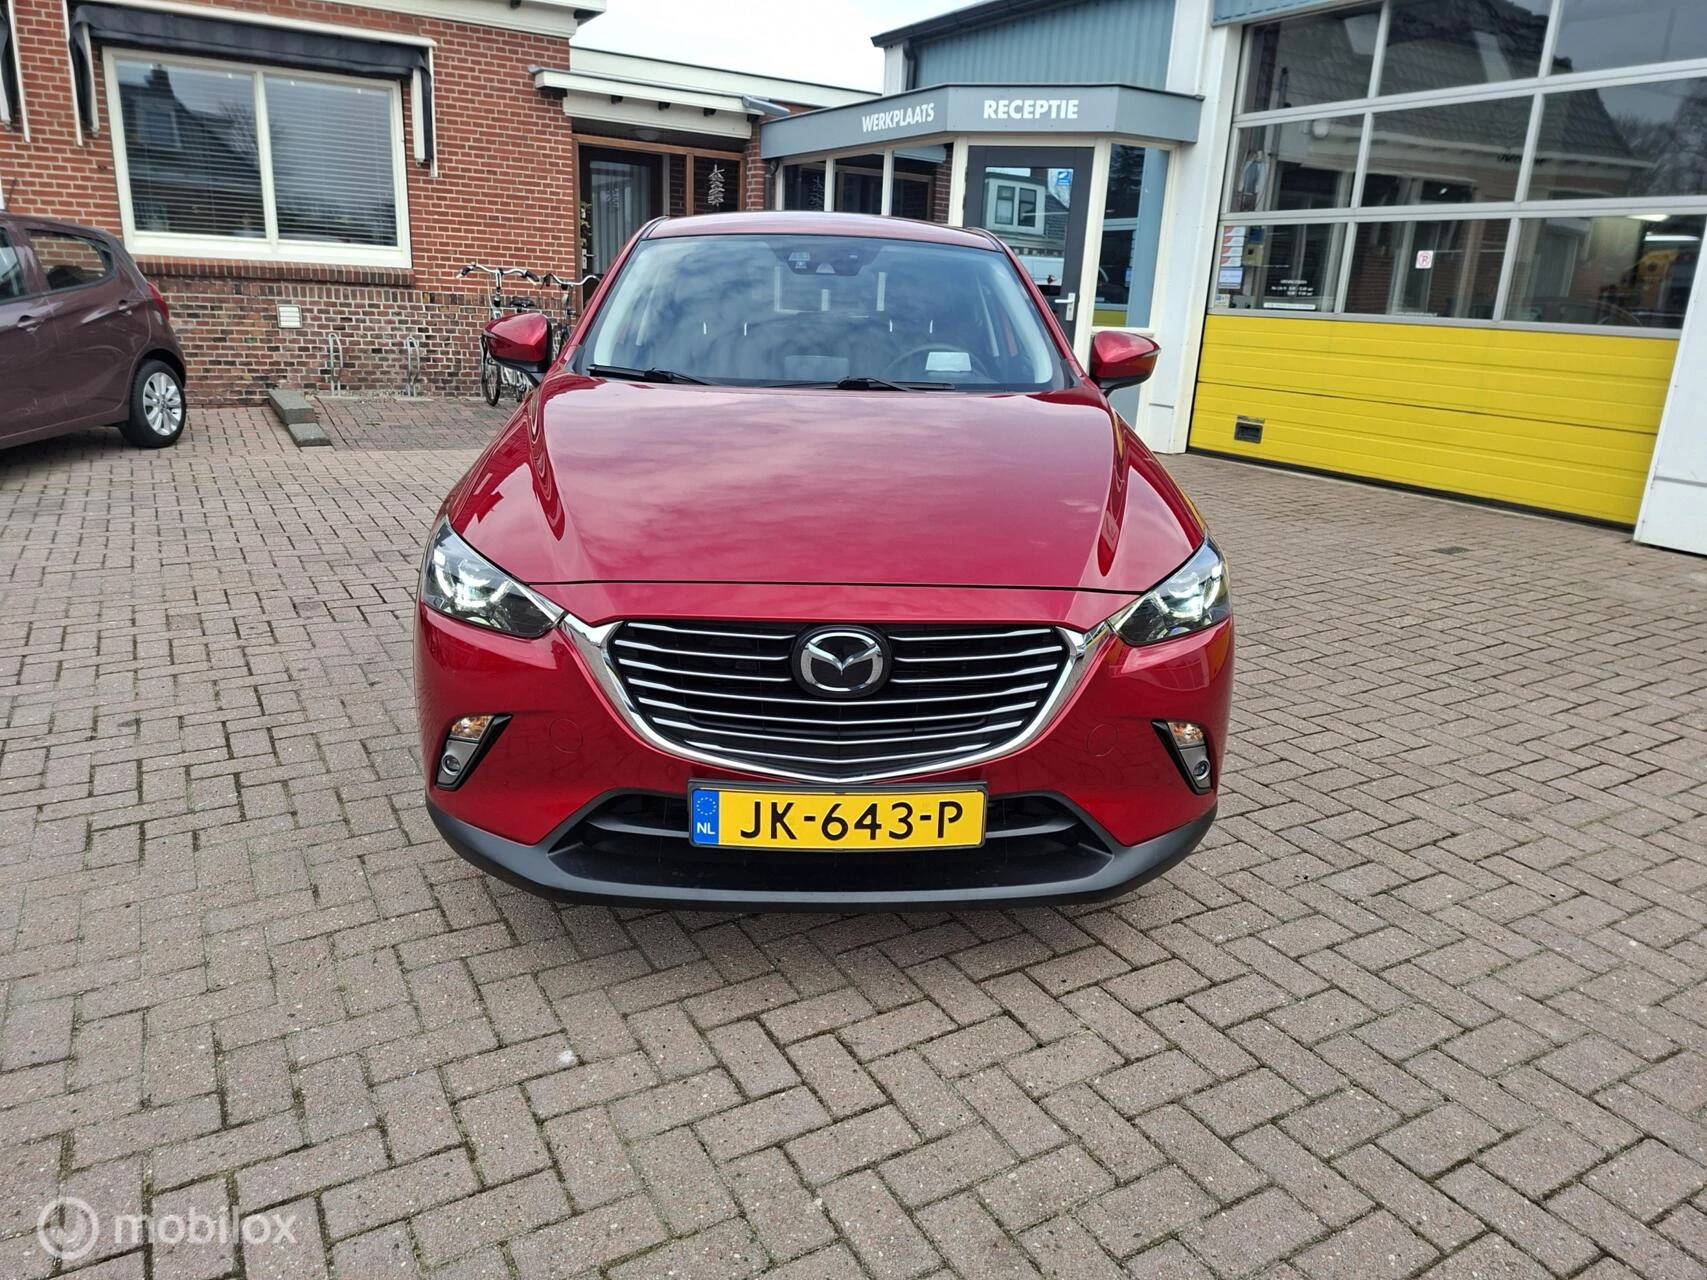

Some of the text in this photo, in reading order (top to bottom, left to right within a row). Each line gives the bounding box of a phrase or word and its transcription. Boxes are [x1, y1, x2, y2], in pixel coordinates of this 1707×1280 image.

[862, 103, 935, 133] WERKPLAATS
[983, 99, 1079, 120] RECEPTIE
[697, 822, 715, 835] NL
[740, 801, 963, 841] JK-643-P
